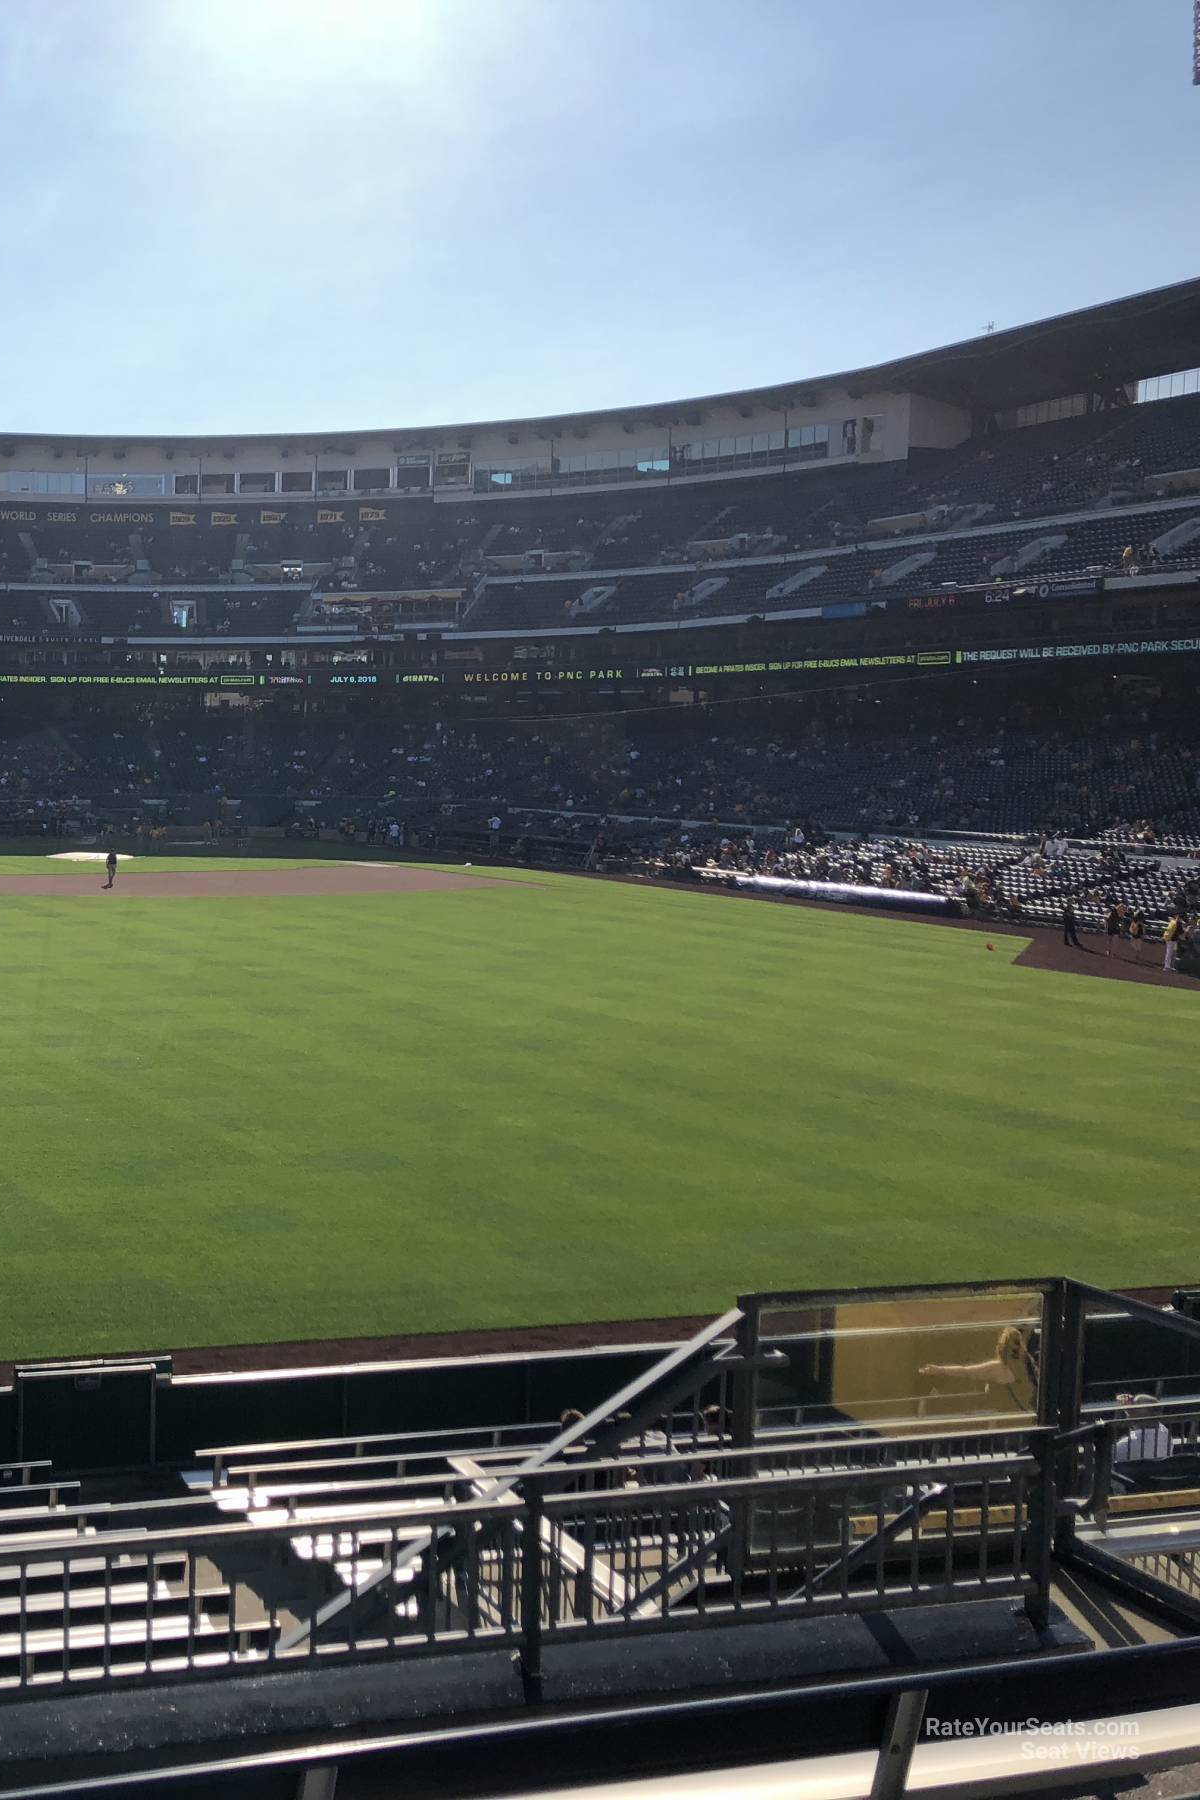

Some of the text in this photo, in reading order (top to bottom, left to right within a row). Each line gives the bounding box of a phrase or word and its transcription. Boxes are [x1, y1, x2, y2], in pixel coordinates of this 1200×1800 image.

[0, 511, 154, 523] WORLD SERIES CHAMPIONS
[984, 589, 1010, 603] 6:24
[962, 639, 1200, 661] THE REQUEST WILL BE RECEIVED BY PNC PARK SECU
[696, 666, 718, 674] BECOME
[804, 660, 818, 668] FREE
[860, 656, 906, 666] NEWSLETTERS
[906, 654, 916, 664] AT
[464, 670, 623, 682] WELCOME TO PNC PARK
